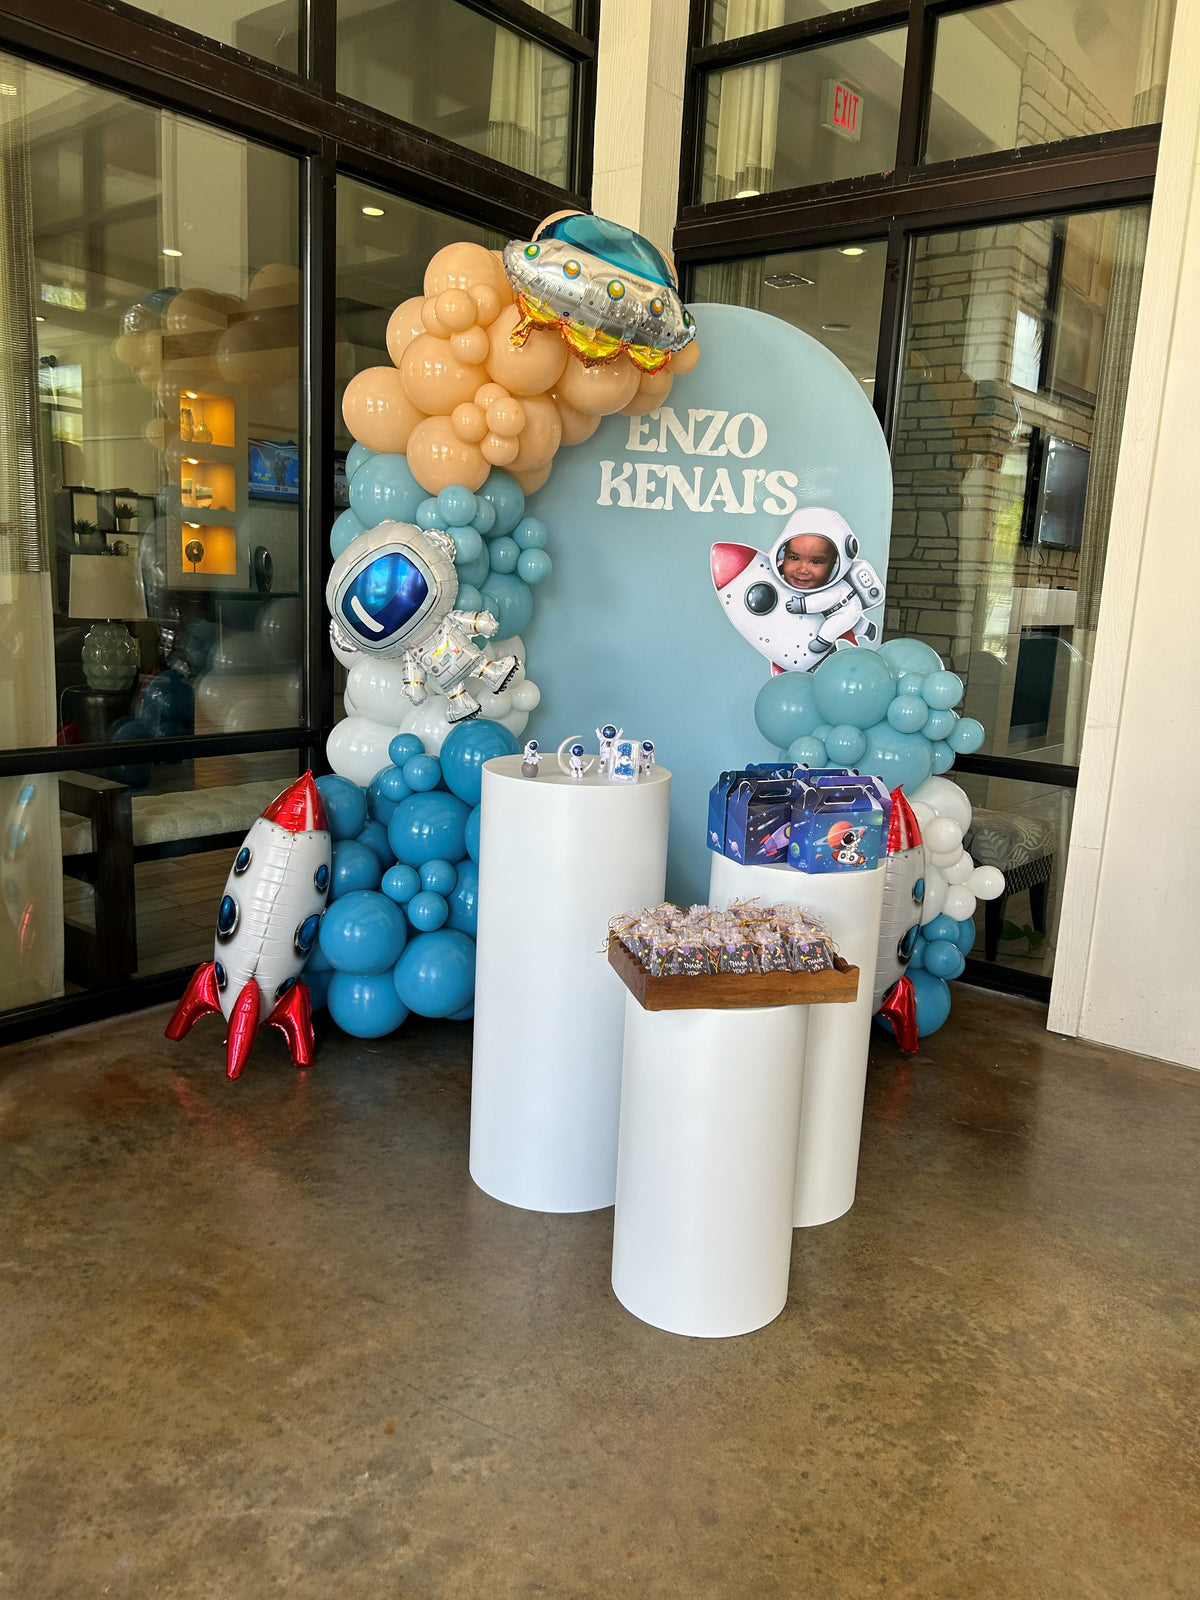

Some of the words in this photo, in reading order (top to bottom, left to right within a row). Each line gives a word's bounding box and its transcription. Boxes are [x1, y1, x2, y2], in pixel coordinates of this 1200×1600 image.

[833, 84, 859, 133] EXIT
[625, 407, 768, 458] ENZO
[596, 461, 799, 515] KENAI'S
